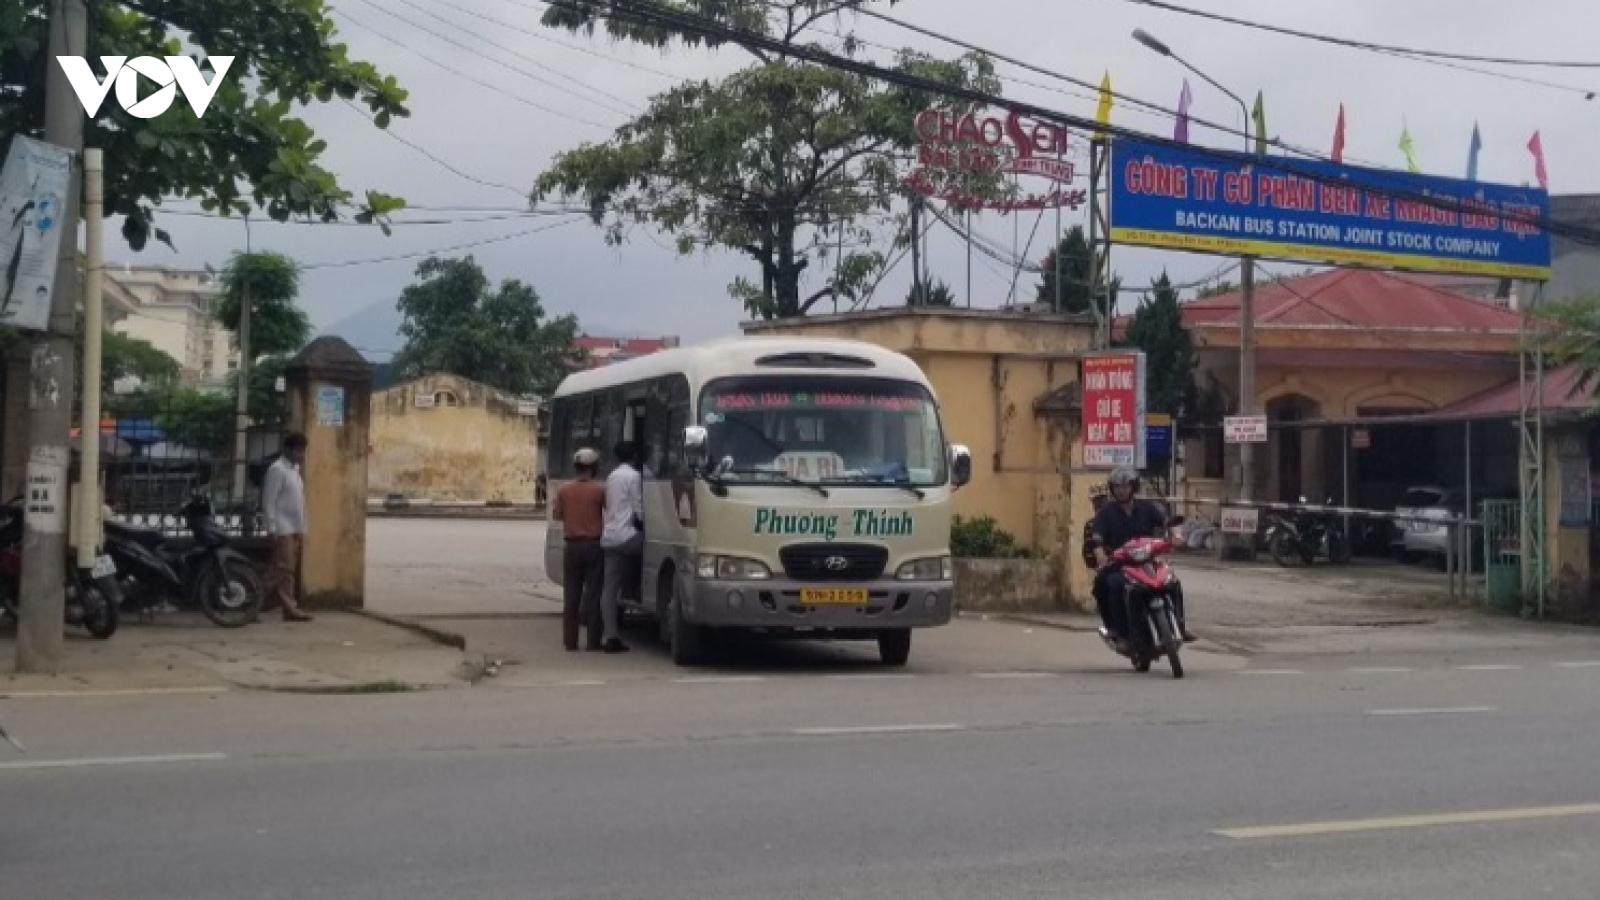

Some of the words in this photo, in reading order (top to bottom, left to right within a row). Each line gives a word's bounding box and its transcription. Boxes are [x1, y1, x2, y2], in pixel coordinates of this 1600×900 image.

[1125, 155, 1188, 198] CÔNG
[1191, 167, 1218, 201] TY
[1175, 210, 1240, 231] BACKAN
[1244, 216, 1274, 235] BUS
[1278, 220, 1341, 242] STATION
[1343, 228, 1384, 246] JOINT
[1387, 231, 1433, 250] STOCK
[1434, 235, 1501, 257] COMPANY
[754, 506, 839, 541] Phương
[853, 508, 913, 541] Thịnh
